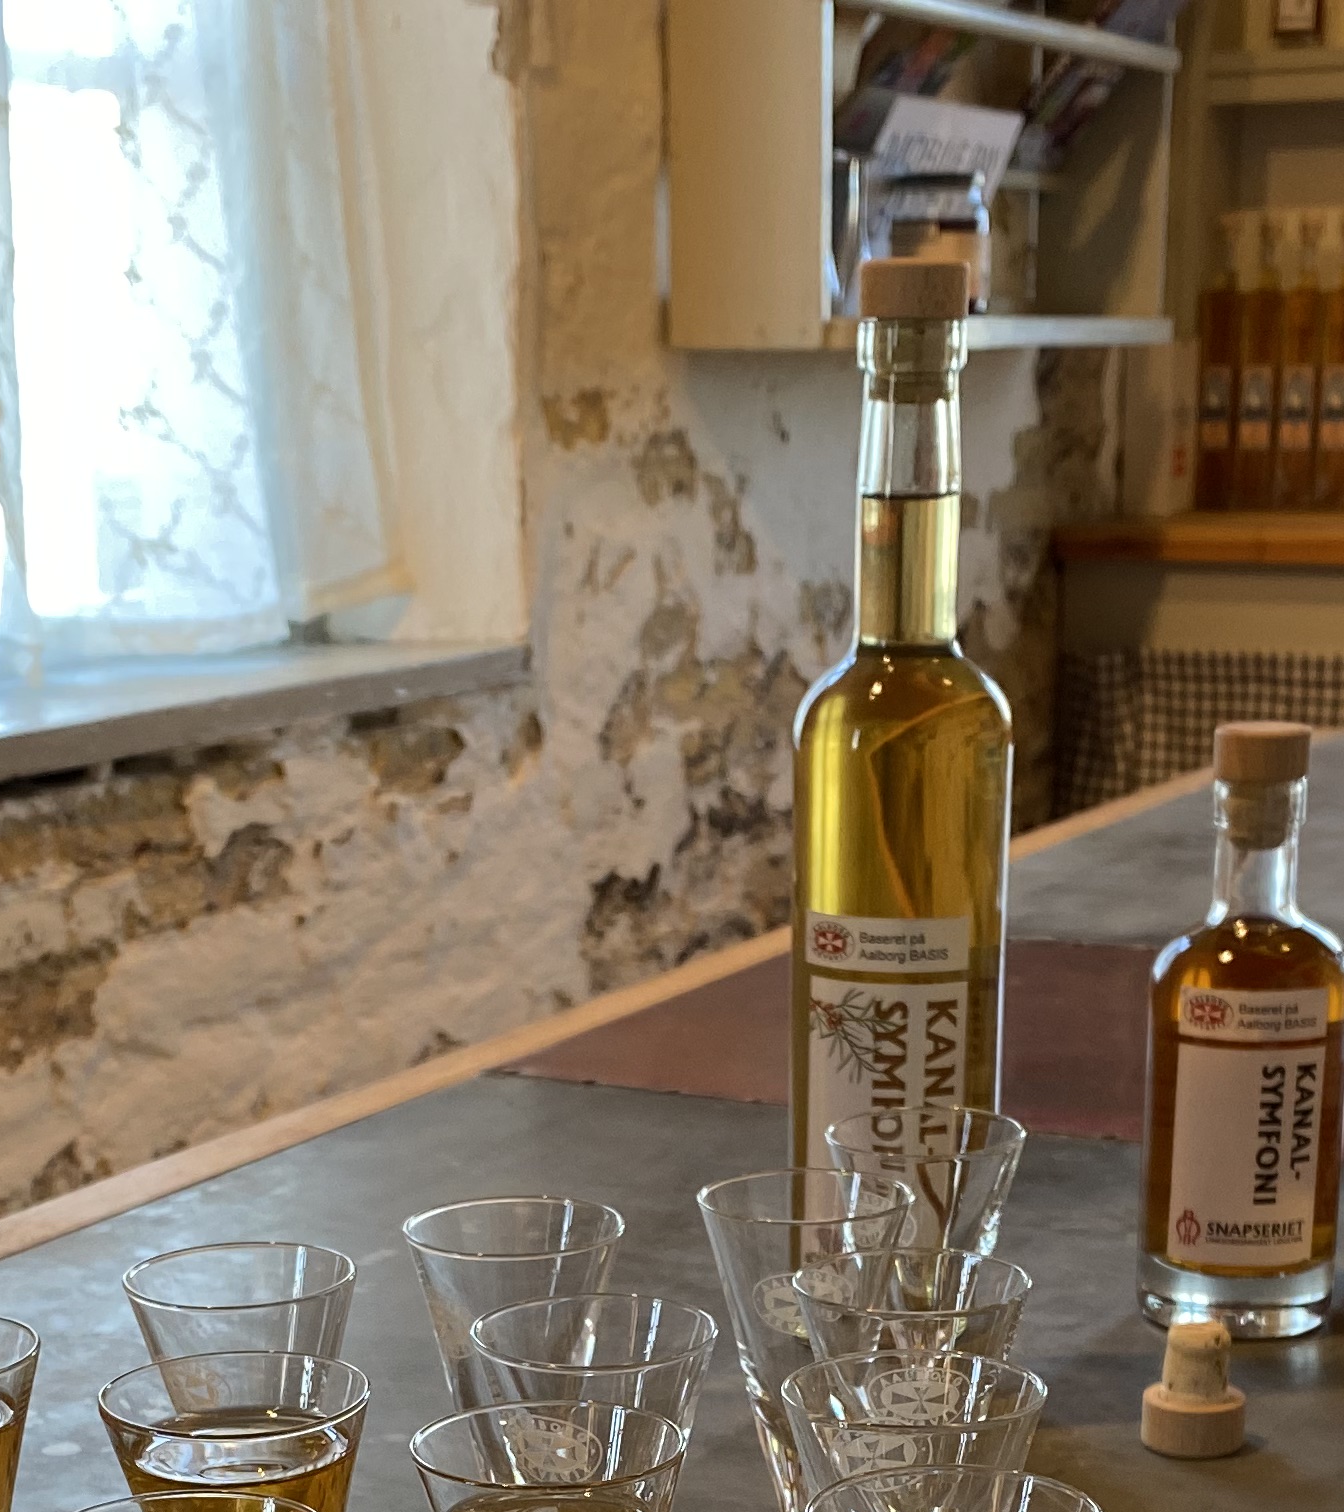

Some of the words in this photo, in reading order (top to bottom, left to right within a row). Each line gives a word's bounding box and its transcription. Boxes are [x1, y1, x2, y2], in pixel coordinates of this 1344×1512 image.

[859, 932, 906, 945] Baseret
[859, 949, 906, 965] Aalborg
[909, 949, 950, 962] BASIS
[1238, 1003, 1283, 1015] Baseret
[1237, 1018, 1282, 1032] Aalborg
[1289, 1062, 1318, 1181] KANAL-
[1253, 1065, 1286, 1206] SYMFONI
[1206, 1219, 1305, 1239] SNAPSERIET
